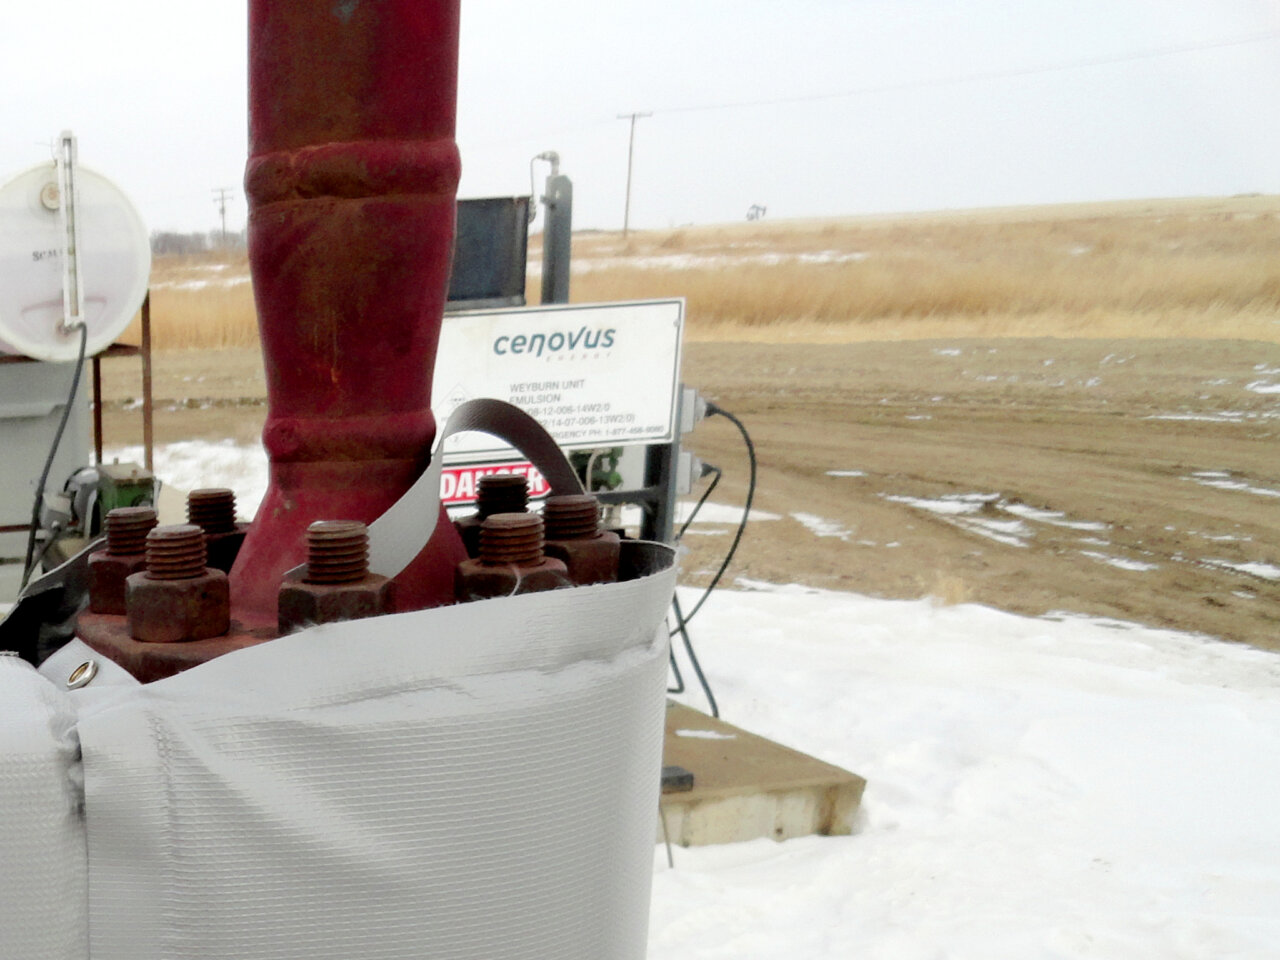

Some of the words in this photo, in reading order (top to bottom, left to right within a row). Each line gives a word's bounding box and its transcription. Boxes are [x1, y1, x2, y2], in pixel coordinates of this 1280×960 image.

[493, 325, 616, 358] cenovus
[510, 380, 559, 393] WEYBURN
[562, 379, 586, 391] UNIT
[509, 394, 561, 405] EMULSION
[552, 430, 586, 439] RGENCY
[440, 467, 543, 499] DAR
